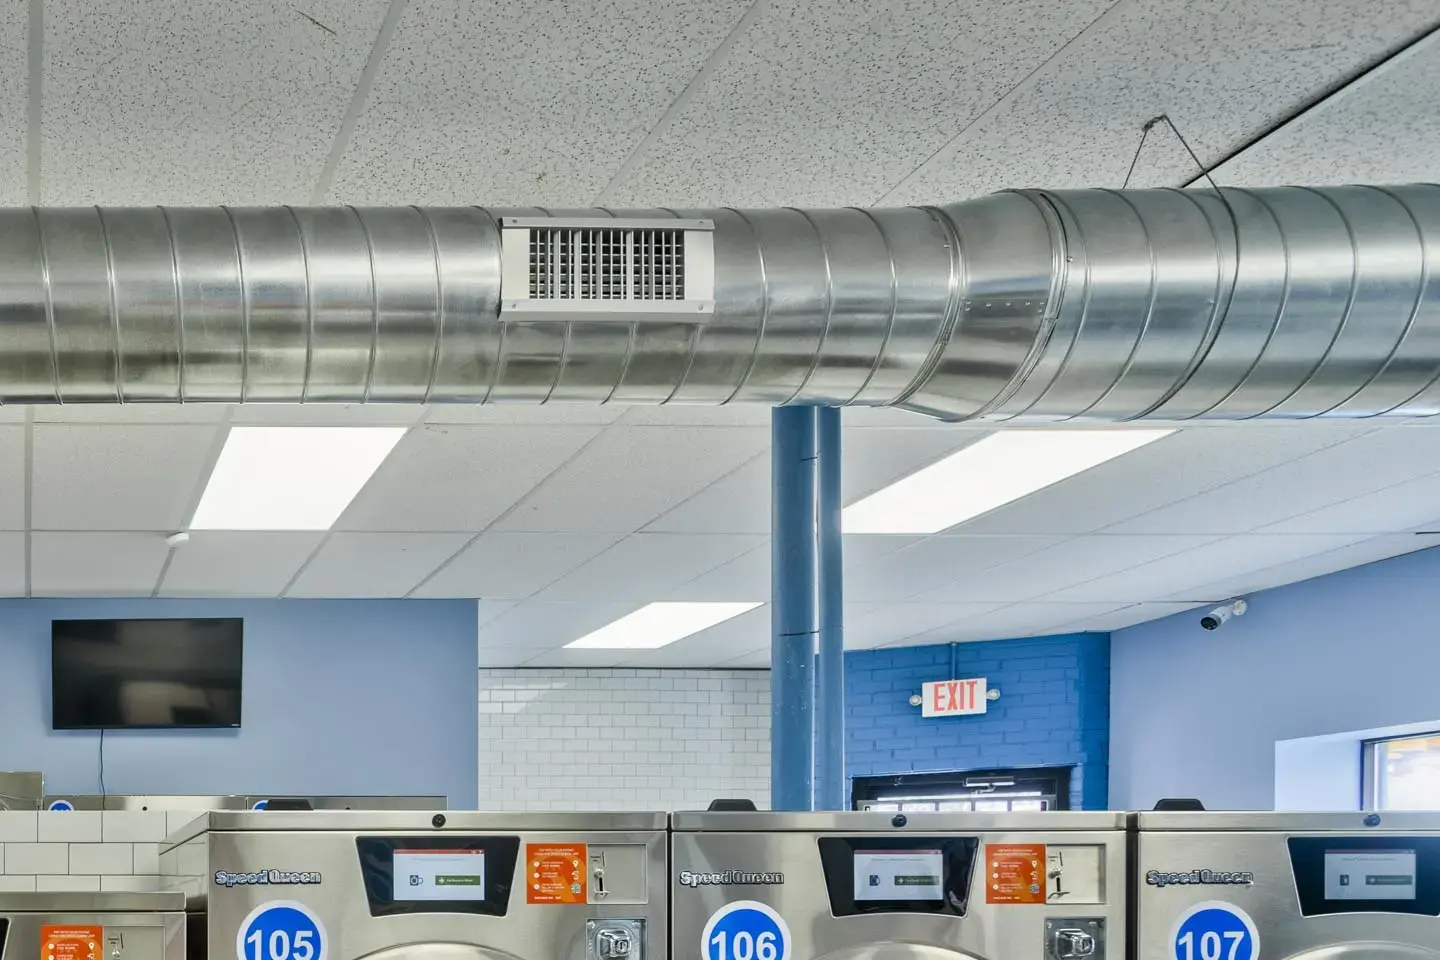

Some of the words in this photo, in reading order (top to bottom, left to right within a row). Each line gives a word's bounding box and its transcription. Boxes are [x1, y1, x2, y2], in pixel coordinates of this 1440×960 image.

[933, 681, 977, 712] EXIT
[215, 869, 268, 888] Speed
[268, 869, 321, 885] Queen
[680, 870, 732, 888] Speed
[732, 870, 784, 885] Queen
[1146, 869, 1200, 888] Speed
[1200, 869, 1253, 885] Queen
